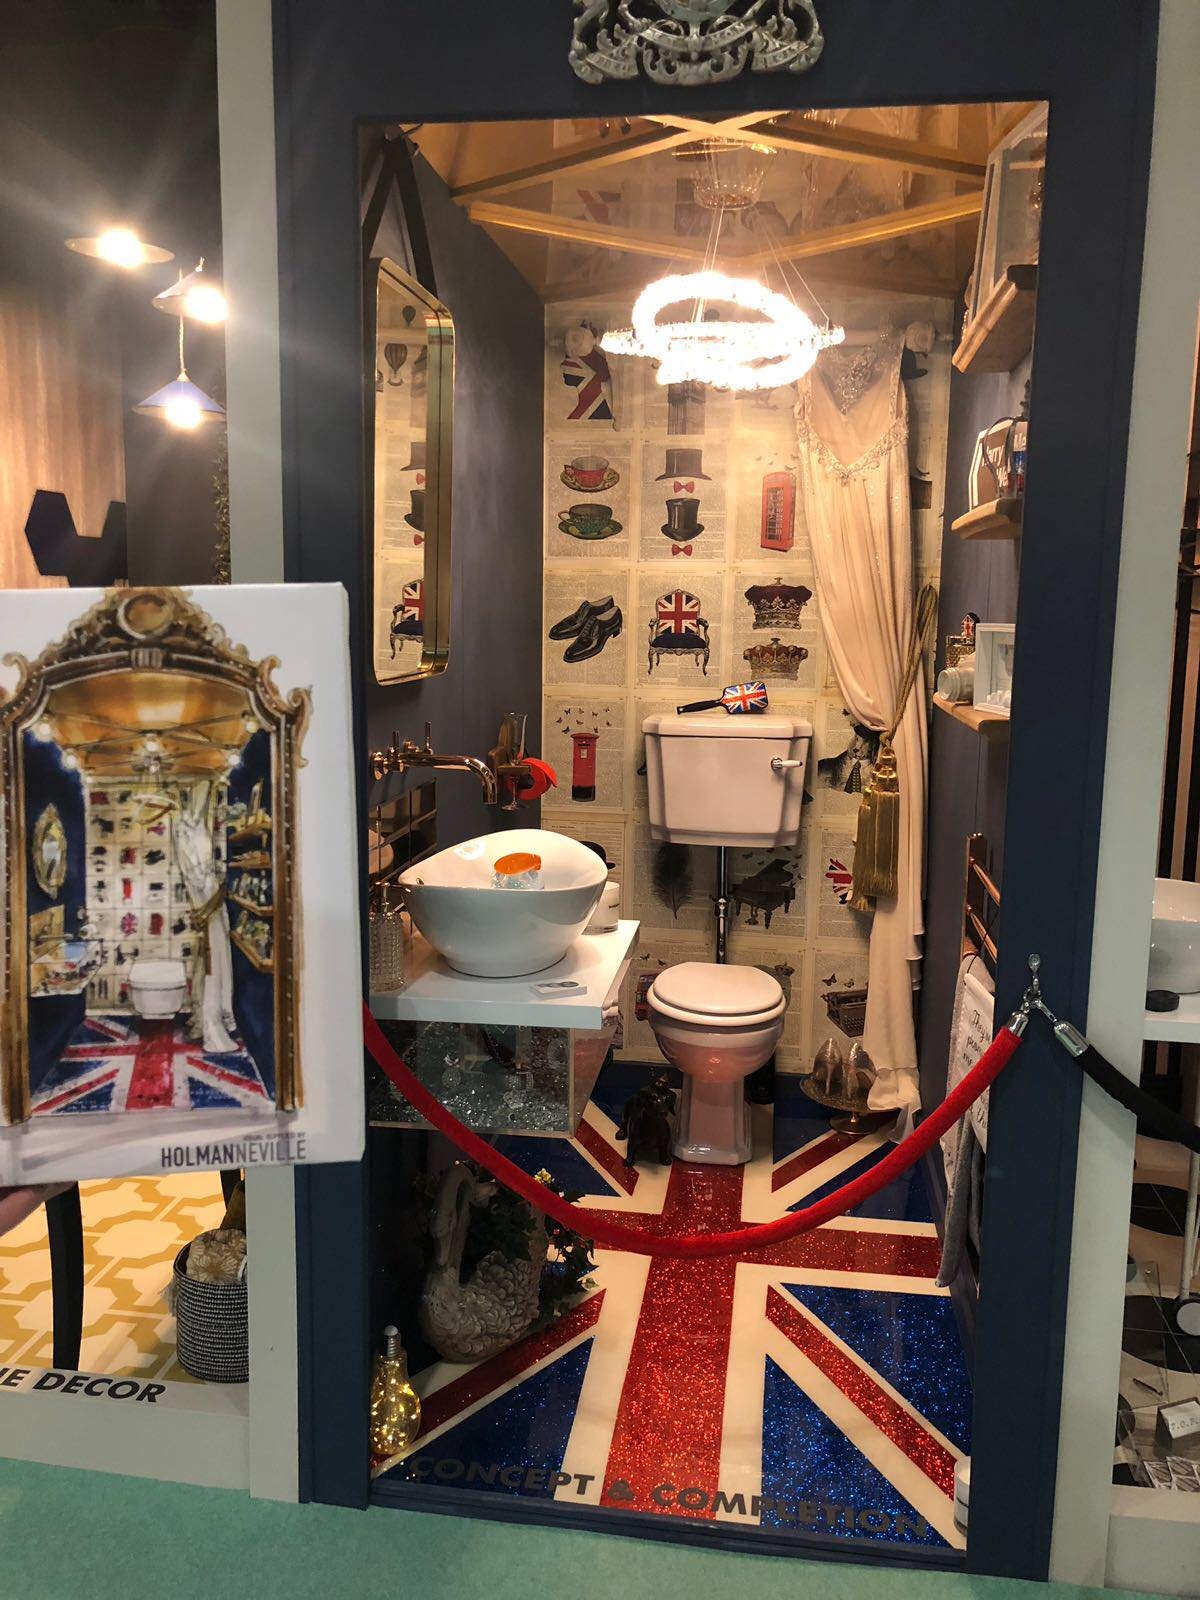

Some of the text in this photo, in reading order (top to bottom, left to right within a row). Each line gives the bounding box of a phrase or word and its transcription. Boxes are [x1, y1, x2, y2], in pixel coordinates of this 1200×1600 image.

[32, 1372, 166, 1403] DECOR
[408, 1456, 929, 1538] CONCEPT & COMPLETION
